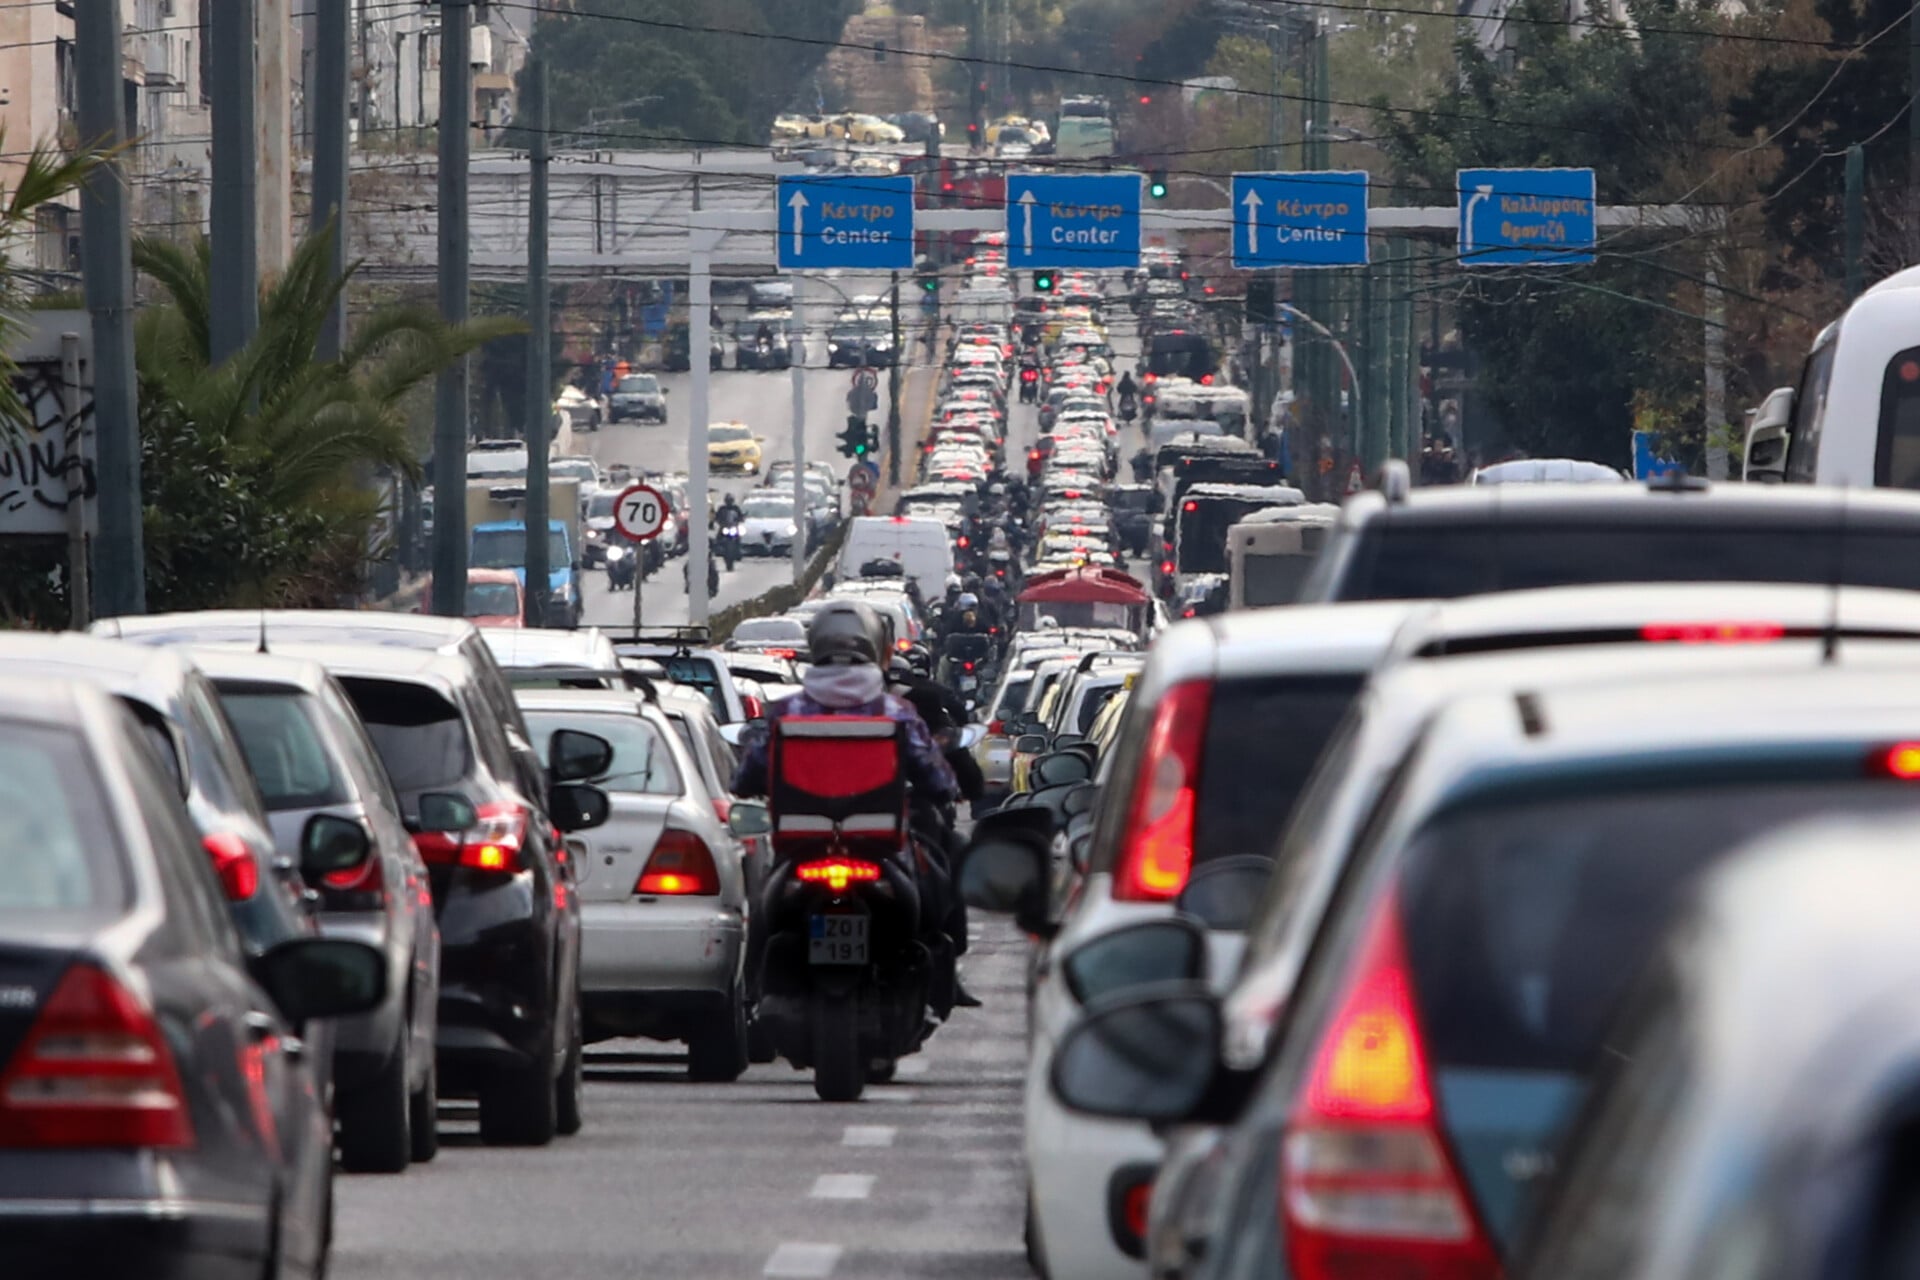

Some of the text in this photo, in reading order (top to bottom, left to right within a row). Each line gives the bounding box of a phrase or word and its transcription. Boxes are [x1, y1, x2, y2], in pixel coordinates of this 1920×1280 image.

[822, 201, 895, 222] Κέντρο
[1051, 202, 1123, 223] Κέντρο
[1276, 199, 1349, 220] Κέντρο
[821, 226, 892, 245] Center
[1051, 226, 1120, 244] Center
[1277, 225, 1346, 244] Center
[625, 502, 656, 524] 70
[826, 941, 865, 960] 191
